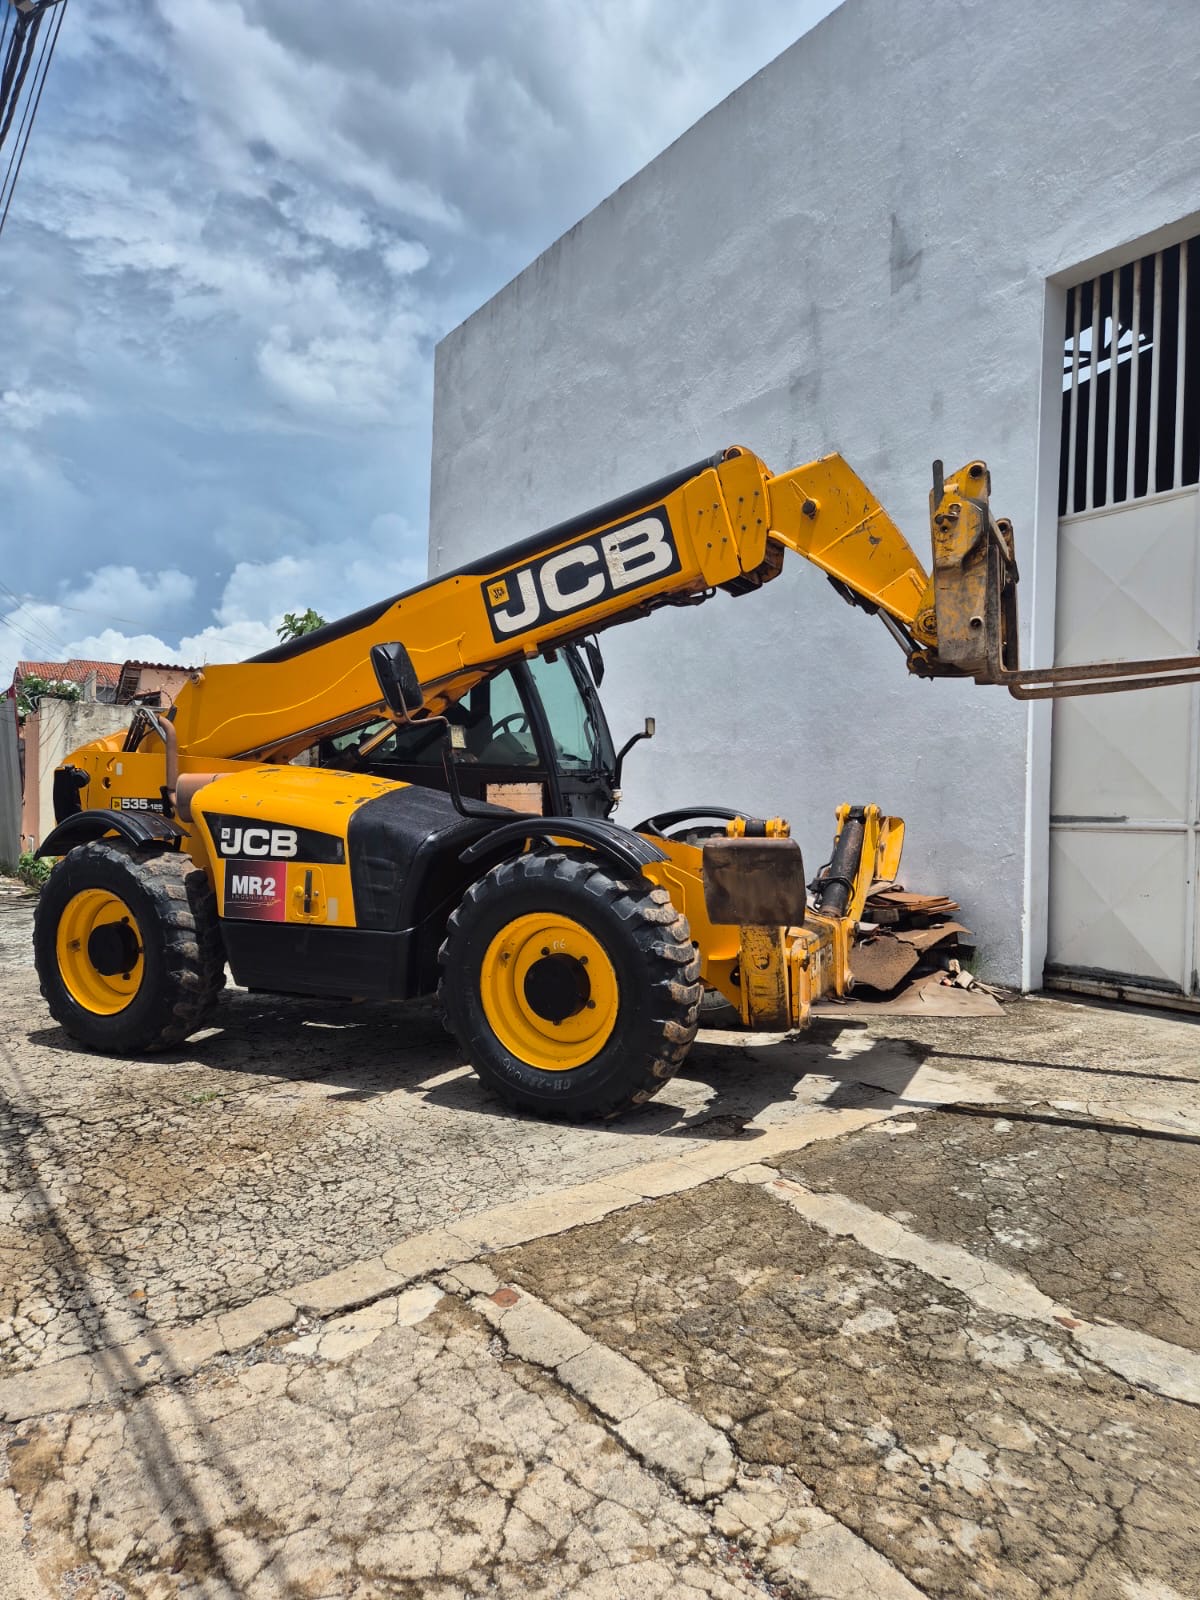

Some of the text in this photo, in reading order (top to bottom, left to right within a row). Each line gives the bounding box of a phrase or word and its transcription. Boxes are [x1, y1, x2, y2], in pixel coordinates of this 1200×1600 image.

[493, 517, 673, 633] JCB
[220, 828, 298, 857] JCB
[232, 875, 276, 896] MR2
